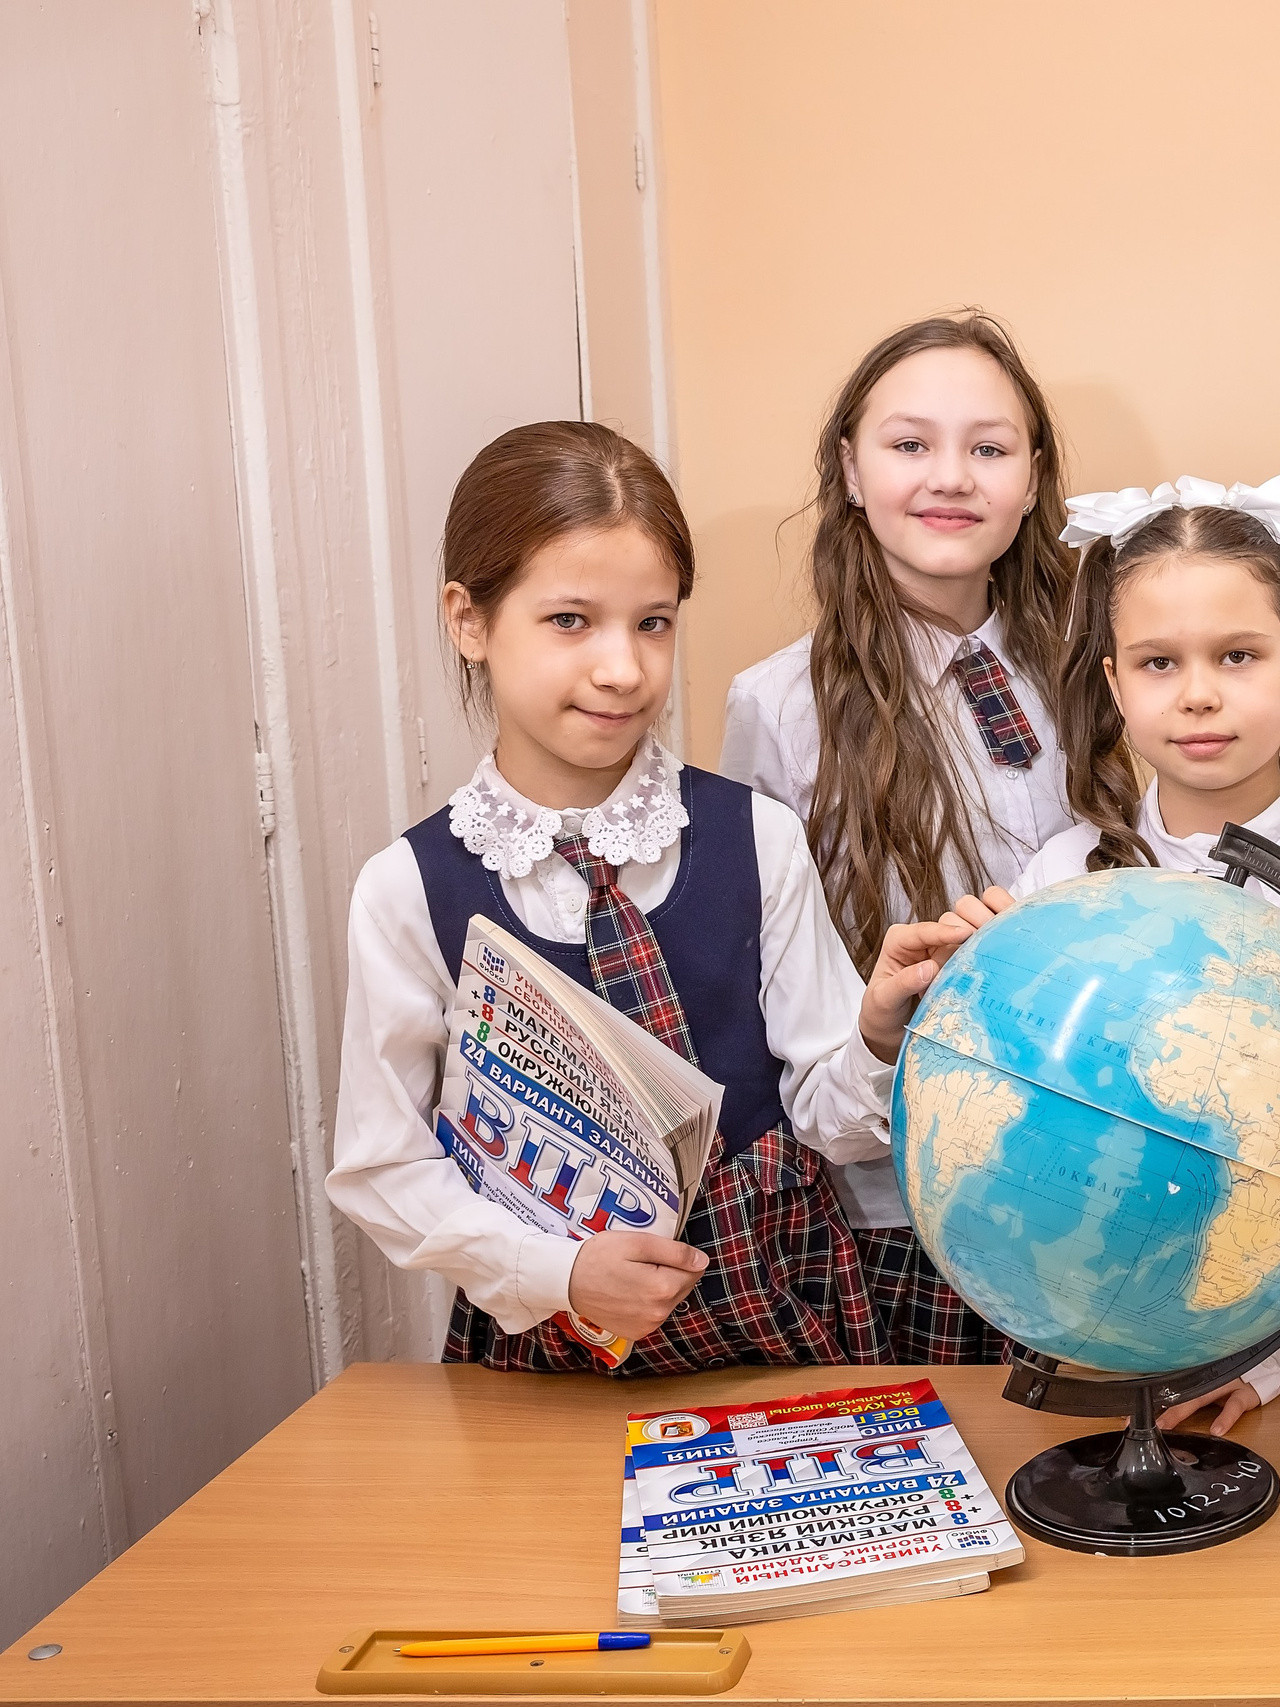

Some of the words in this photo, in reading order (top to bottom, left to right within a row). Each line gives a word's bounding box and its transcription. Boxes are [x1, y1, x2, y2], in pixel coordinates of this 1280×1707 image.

[479, 962, 505, 984] ФИОКО
[514, 985, 574, 1042] СБОРНИК
[484, 985, 496, 1005] 8
[507, 1001, 634, 1122] МАТЕМАТИКА
[482, 1003, 494, 1022] 8
[505, 1020, 594, 1098] РУССКИЙ
[600, 1096, 650, 1152] ЯЗЫК
[477, 1021, 490, 1042] 8
[498, 1041, 631, 1149] ОКРУЖАЮЩИЙ
[636, 1148, 670, 1183] МИР
[464, 1038, 486, 1067] 24
[489, 1063, 583, 1134] ВАРИАНТА
[588, 1130, 668, 1200] ЗАДАНИЙ
[458, 1065, 656, 1235] ВПР
[1058, 1166, 1123, 1199] ОКЕАН
[769, 1402, 823, 1416] ШКОЛЫ
[826, 1391, 911, 1408] НАЧАЛЬНОЙ
[838, 1401, 886, 1416] КУРС
[888, 1397, 915, 1407] ЗА
[872, 1407, 920, 1421] ВСЕ
[861, 1420, 926, 1436] ТИПО
[670, 1435, 944, 1505] ВПР
[790, 1478, 918, 1504] ВАРИАНТА
[927, 1474, 960, 1489] 24
[938, 1488, 956, 1500] 8
[662, 1499, 783, 1527] ЗАДАНИЙ
[729, 1493, 924, 1532] ОКРУЖАЮЩИЙ
[944, 1500, 963, 1512] 8
[796, 1505, 931, 1538] РУССКИЙ
[951, 1512, 970, 1525] 8
[662, 1523, 720, 1540] МИР
[700, 1527, 787, 1550] ЯЗЫК
[728, 1517, 937, 1559] МАТЕМАТИКА
[951, 1529, 988, 1537] ФИОКО
[844, 1535, 939, 1557] СБОРНИК
[732, 1553, 830, 1575] ЗАДАНИЙ
[735, 1543, 943, 1585] УНИВЕРСАЛЬНЫЙ
